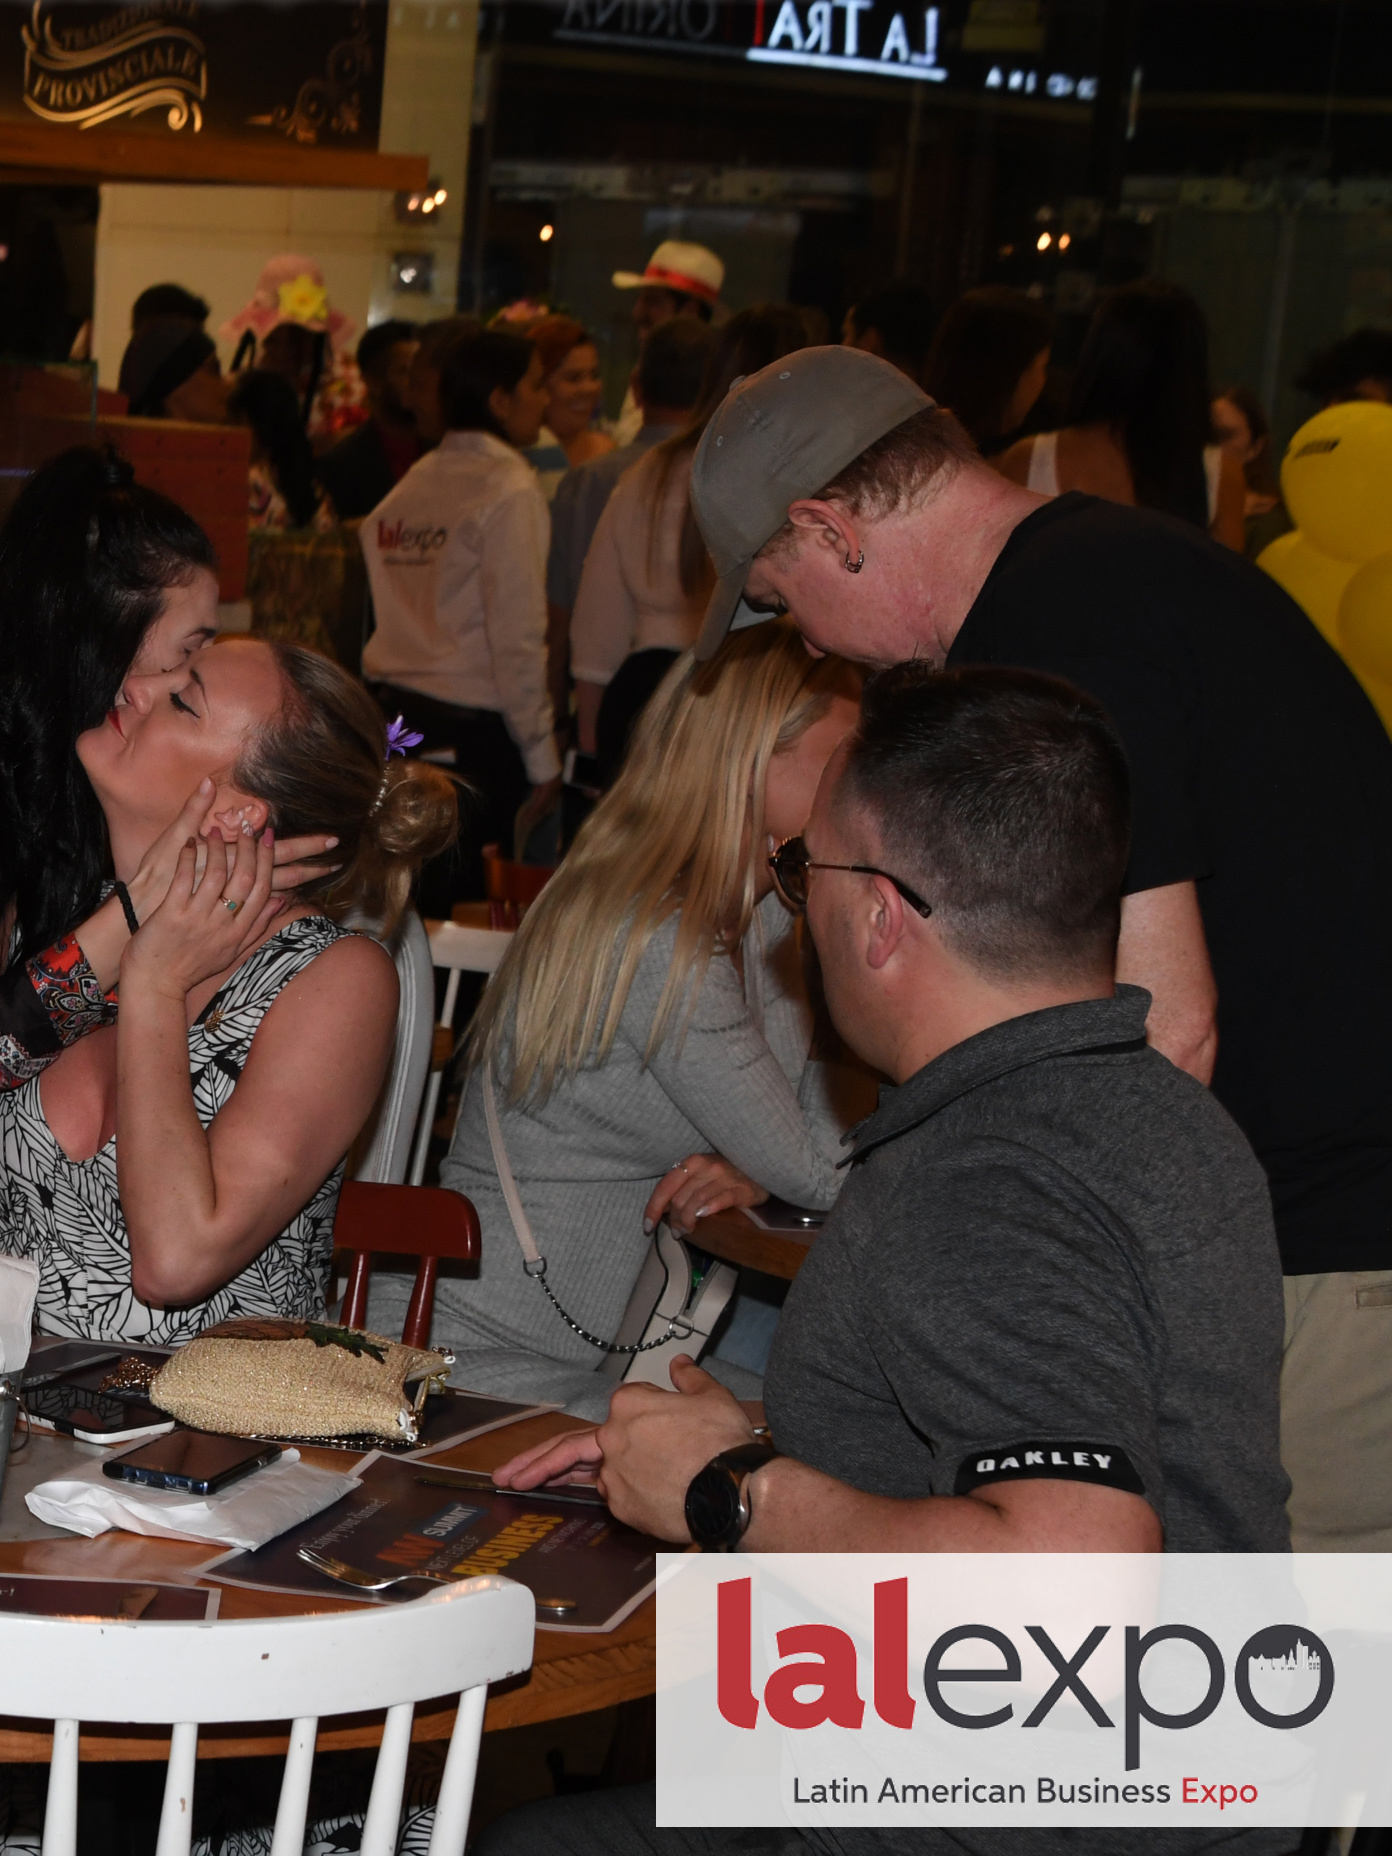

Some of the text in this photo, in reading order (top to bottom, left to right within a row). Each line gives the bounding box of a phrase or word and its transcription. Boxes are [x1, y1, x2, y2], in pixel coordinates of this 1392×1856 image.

[32, 44, 201, 107] PROVINCIALE
[976, 1450, 1112, 1473] OAKLEY
[422, 1503, 478, 1537] SUMMIT
[451, 1513, 564, 1576] BUSINESS
